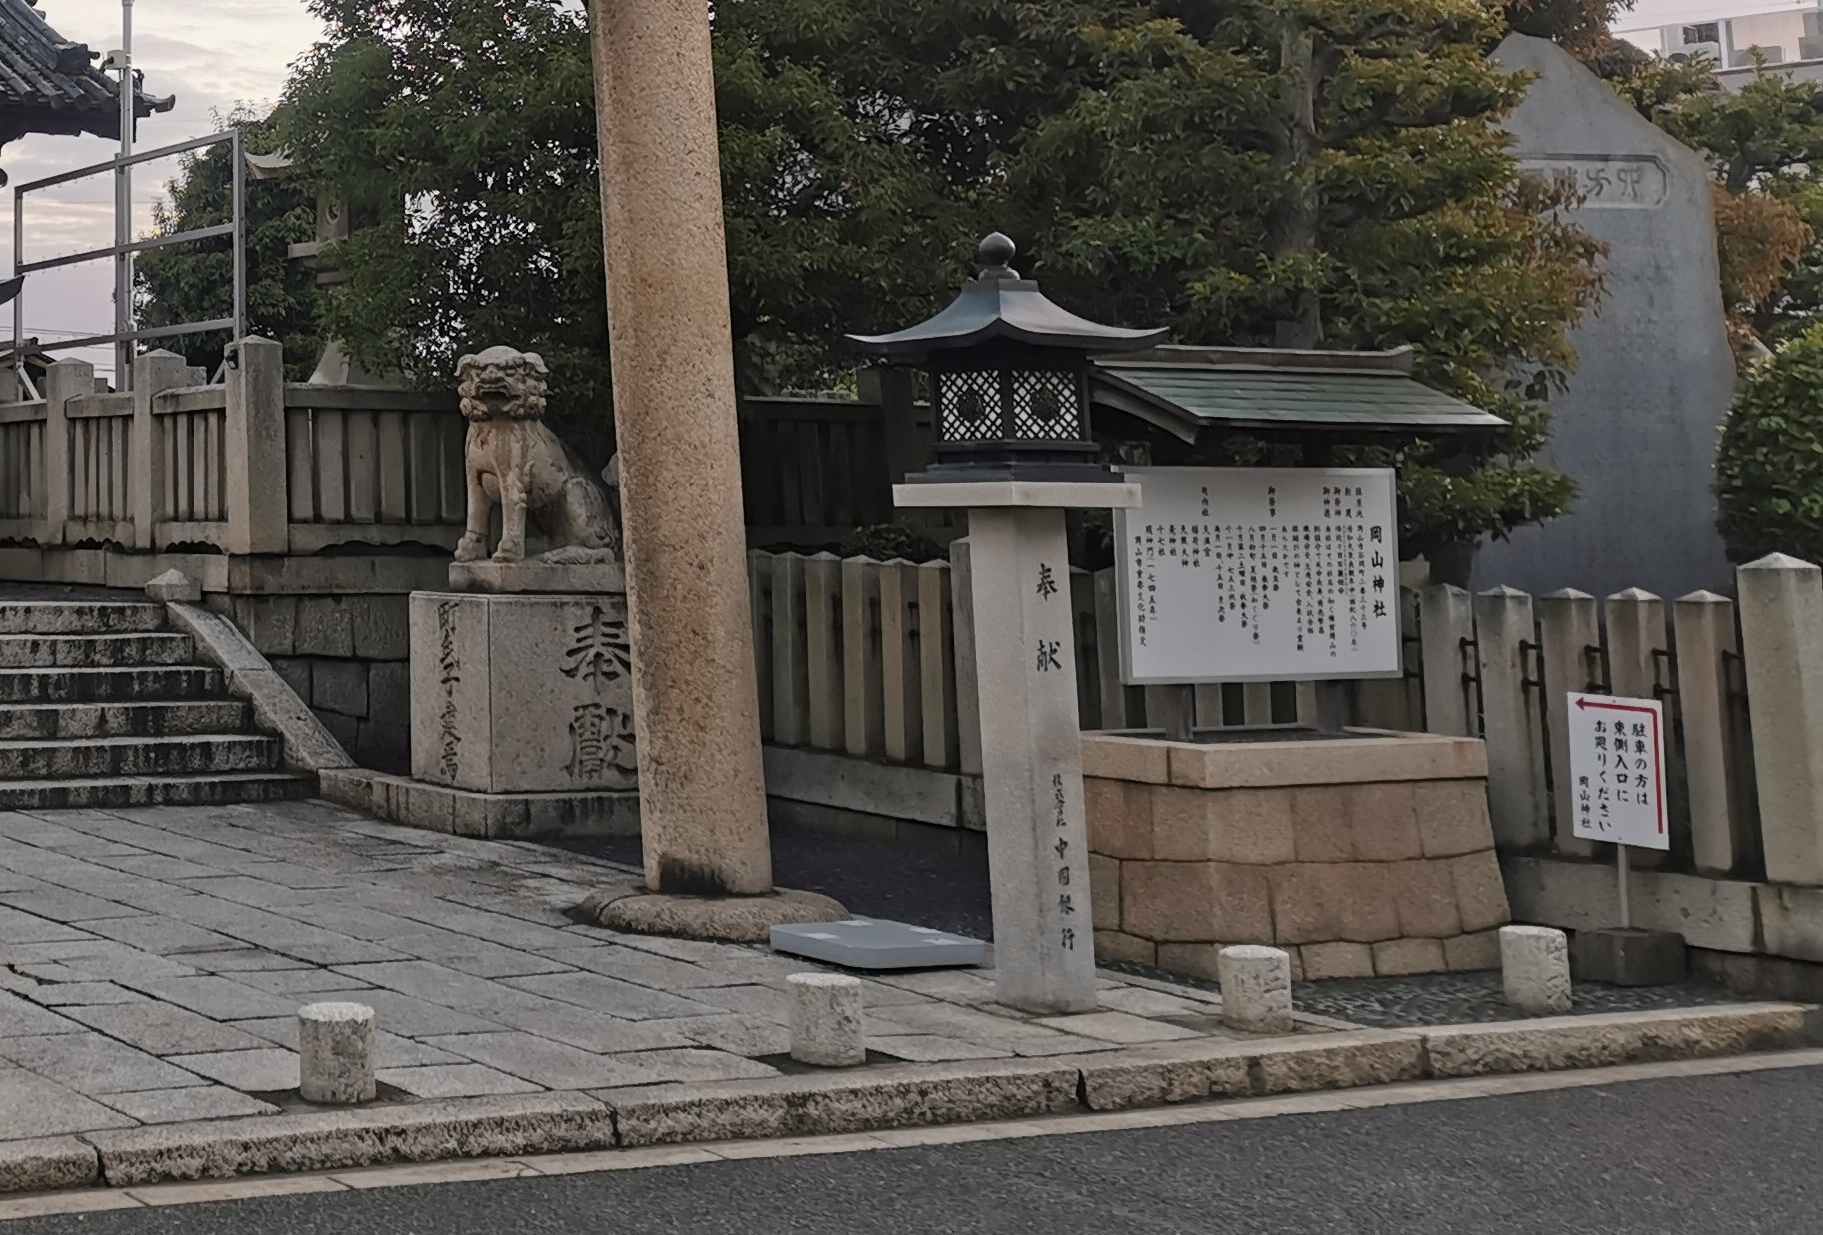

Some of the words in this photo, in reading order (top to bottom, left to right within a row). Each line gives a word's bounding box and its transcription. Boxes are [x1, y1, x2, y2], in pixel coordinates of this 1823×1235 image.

[1369, 525, 1387, 619] 岡山神社
[1035, 562, 1063, 673] 奉献
[1578, 774, 1594, 830] 岡山神社
[1613, 719, 1630, 804] 東側入口に
[1631, 722, 1651, 807] 駐車の方は
